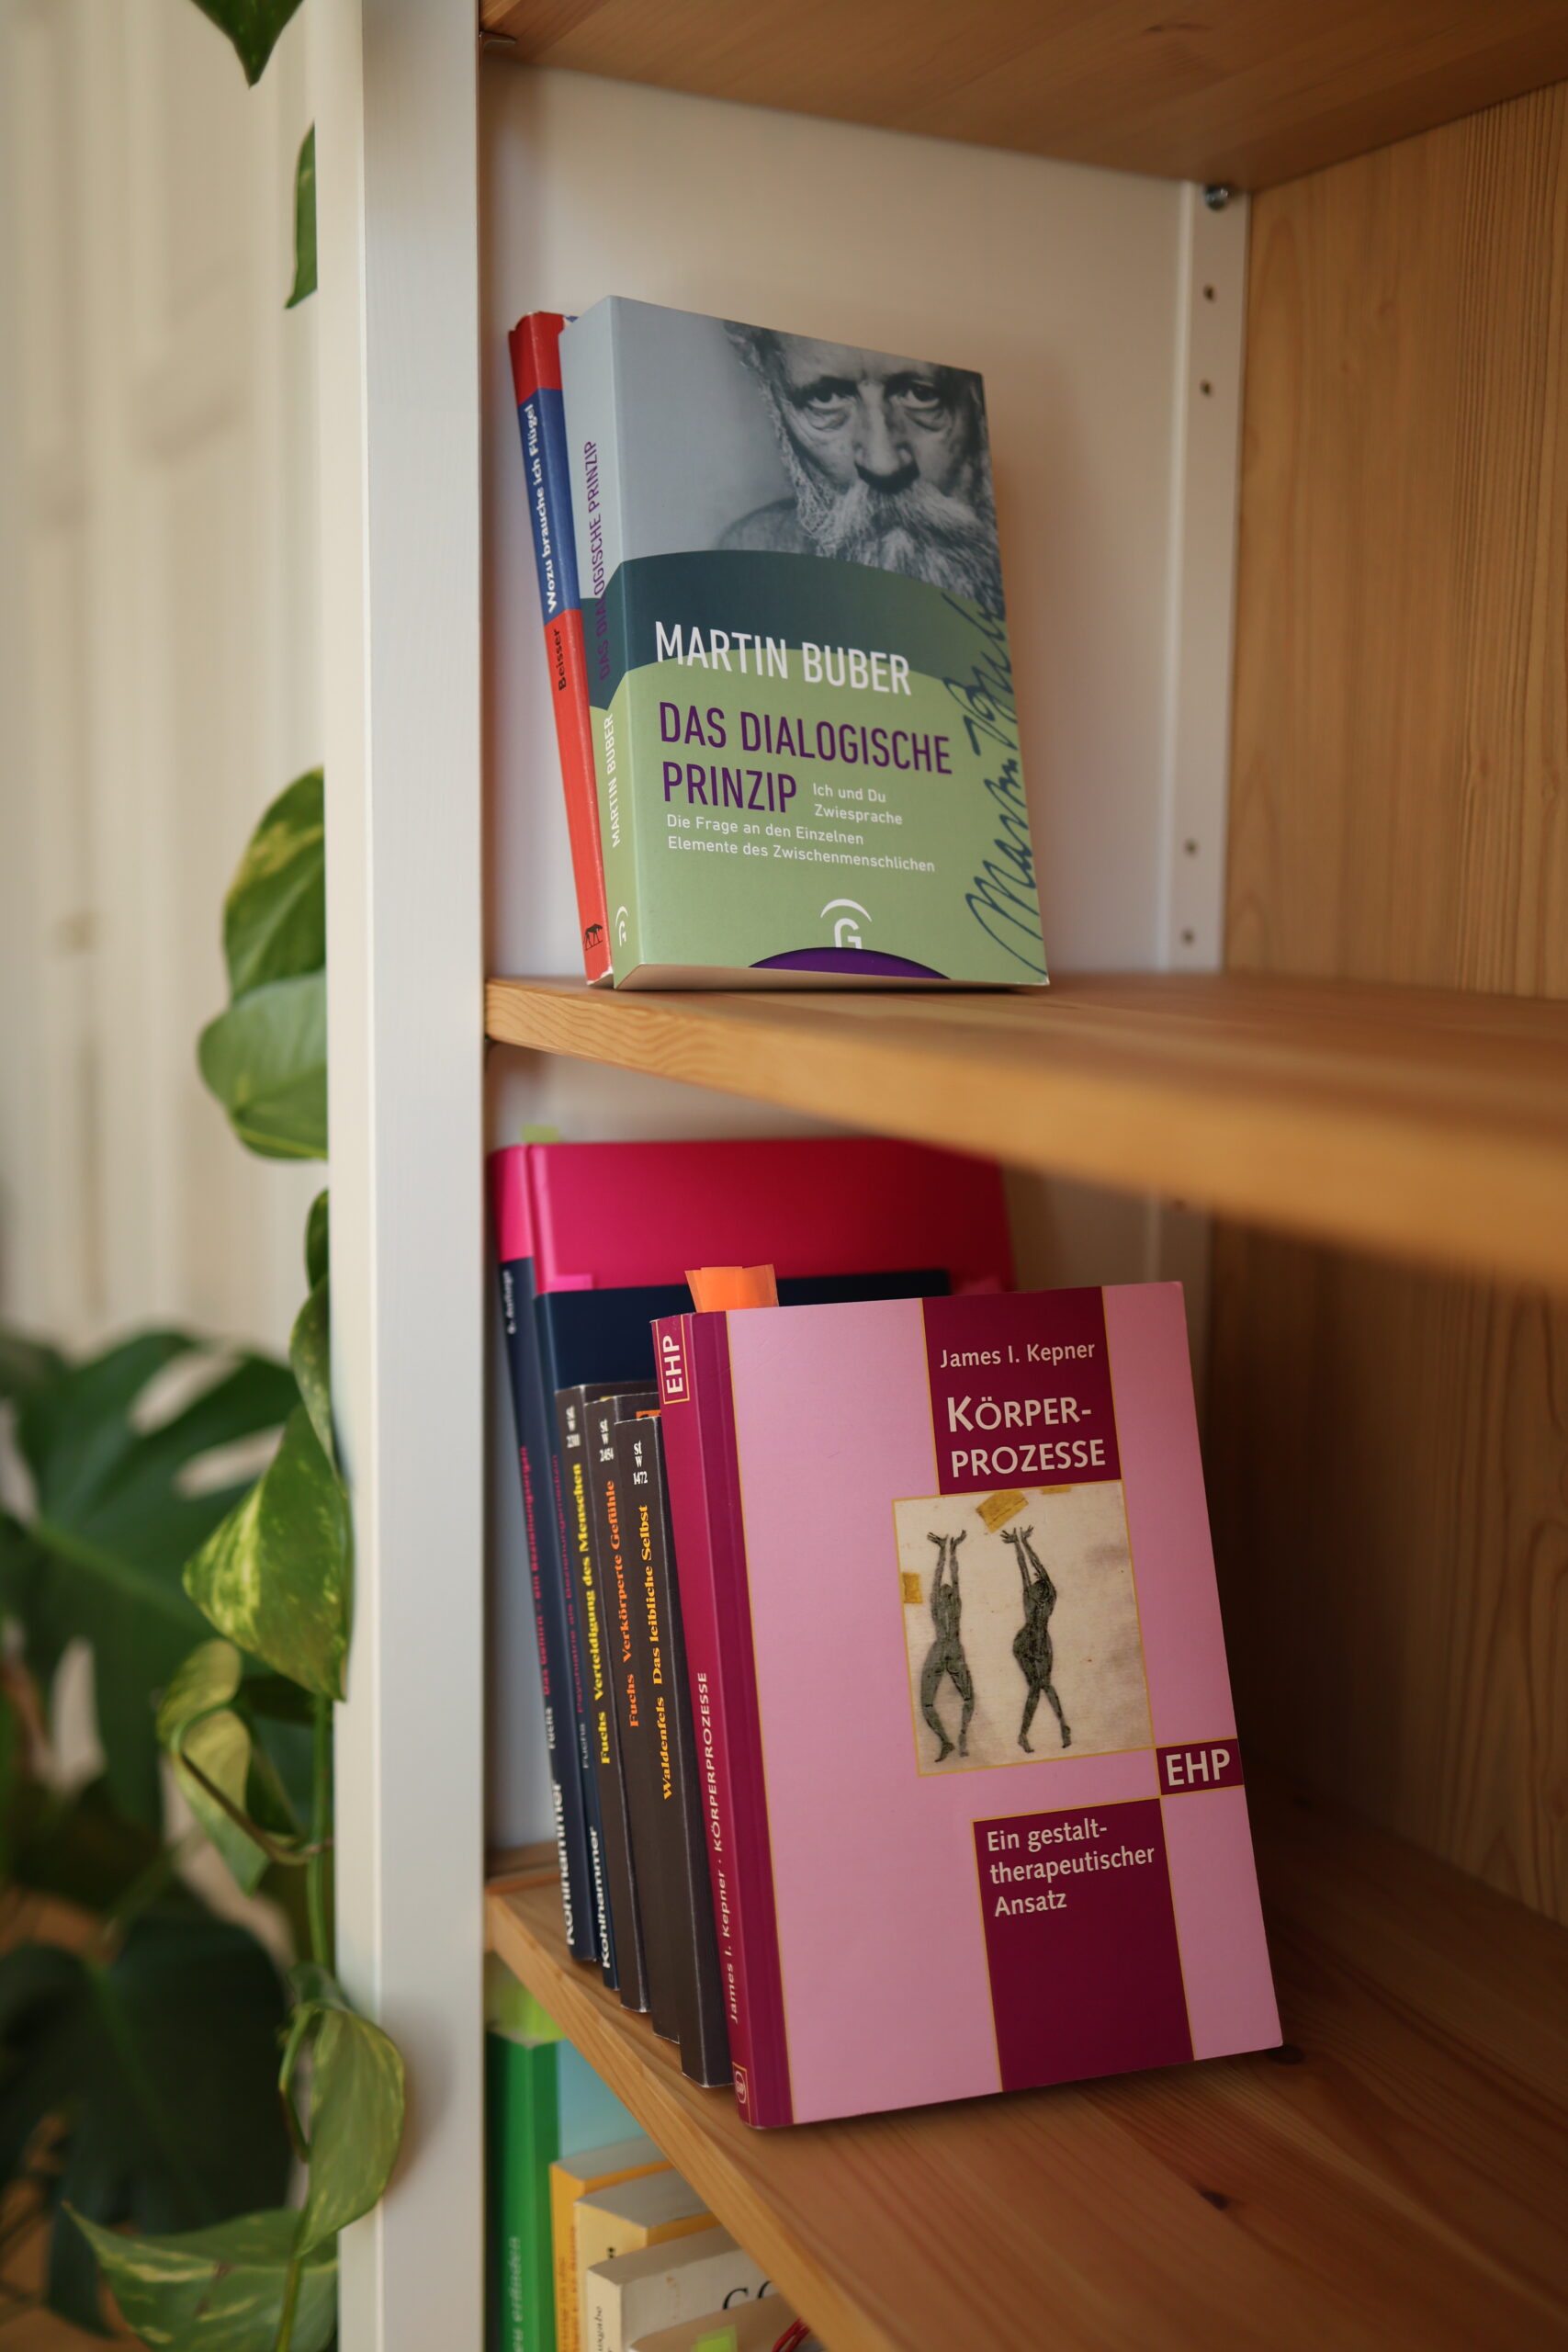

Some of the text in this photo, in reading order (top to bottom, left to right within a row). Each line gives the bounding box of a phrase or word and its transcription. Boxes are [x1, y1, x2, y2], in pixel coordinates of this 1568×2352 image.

[524, 403, 567, 691] Beisser Wozu brauche ich Flügel
[583, 441, 621, 849] MARTIN BUBER DAS DIALOGISCHE PRINZIP
[655, 620, 912, 696] MARTIN BUBER
[659, 701, 953, 775] DAS DIALOGISCHE
[662, 761, 797, 814] PRINZIP
[812, 782, 886, 803] Ich und Du
[666, 813, 864, 846] Die Frage an den Einzelnen
[814, 803, 903, 826] Zwiesprache
[668, 835, 935, 873] Elemente des Zwischenmenschlichen
[662, 1335, 683, 1394] EHP
[940, 1342, 1096, 1369] James I. Kepner
[947, 1395, 1091, 1433] KÖRPER-
[633, 1440, 642, 1454] st
[951, 1438, 1106, 1478] PROZESSE
[632, 1471, 648, 1486] 1472
[519, 1446, 540, 1572] Beziehungsorgan
[532, 1575, 542, 1600] ein
[572, 1463, 611, 1764] Fuchs Verteidigung des Menschen
[605, 1480, 639, 1728] Fuchs Verkörperte Gefühle
[568, 1629, 583, 1713] Psychiatrie
[638, 1504, 672, 1801] Waldenfels Das leibliche Selbst
[579, 1724, 589, 1769] Fuchs
[697, 1672, 722, 1853] KÖRPERPROZESSE
[1165, 1747, 1231, 1787] EHP
[987, 1816, 1108, 1853] Ein gestalt-
[553, 1781, 575, 1946] Kohlhammer
[989, 1844, 1155, 1884] therapeutischer
[589, 1826, 611, 1969] Kohlhammer
[718, 1871, 733, 1939] Kepner
[994, 1890, 1068, 1917] Ansatz
[725, 1962, 739, 2024] James
